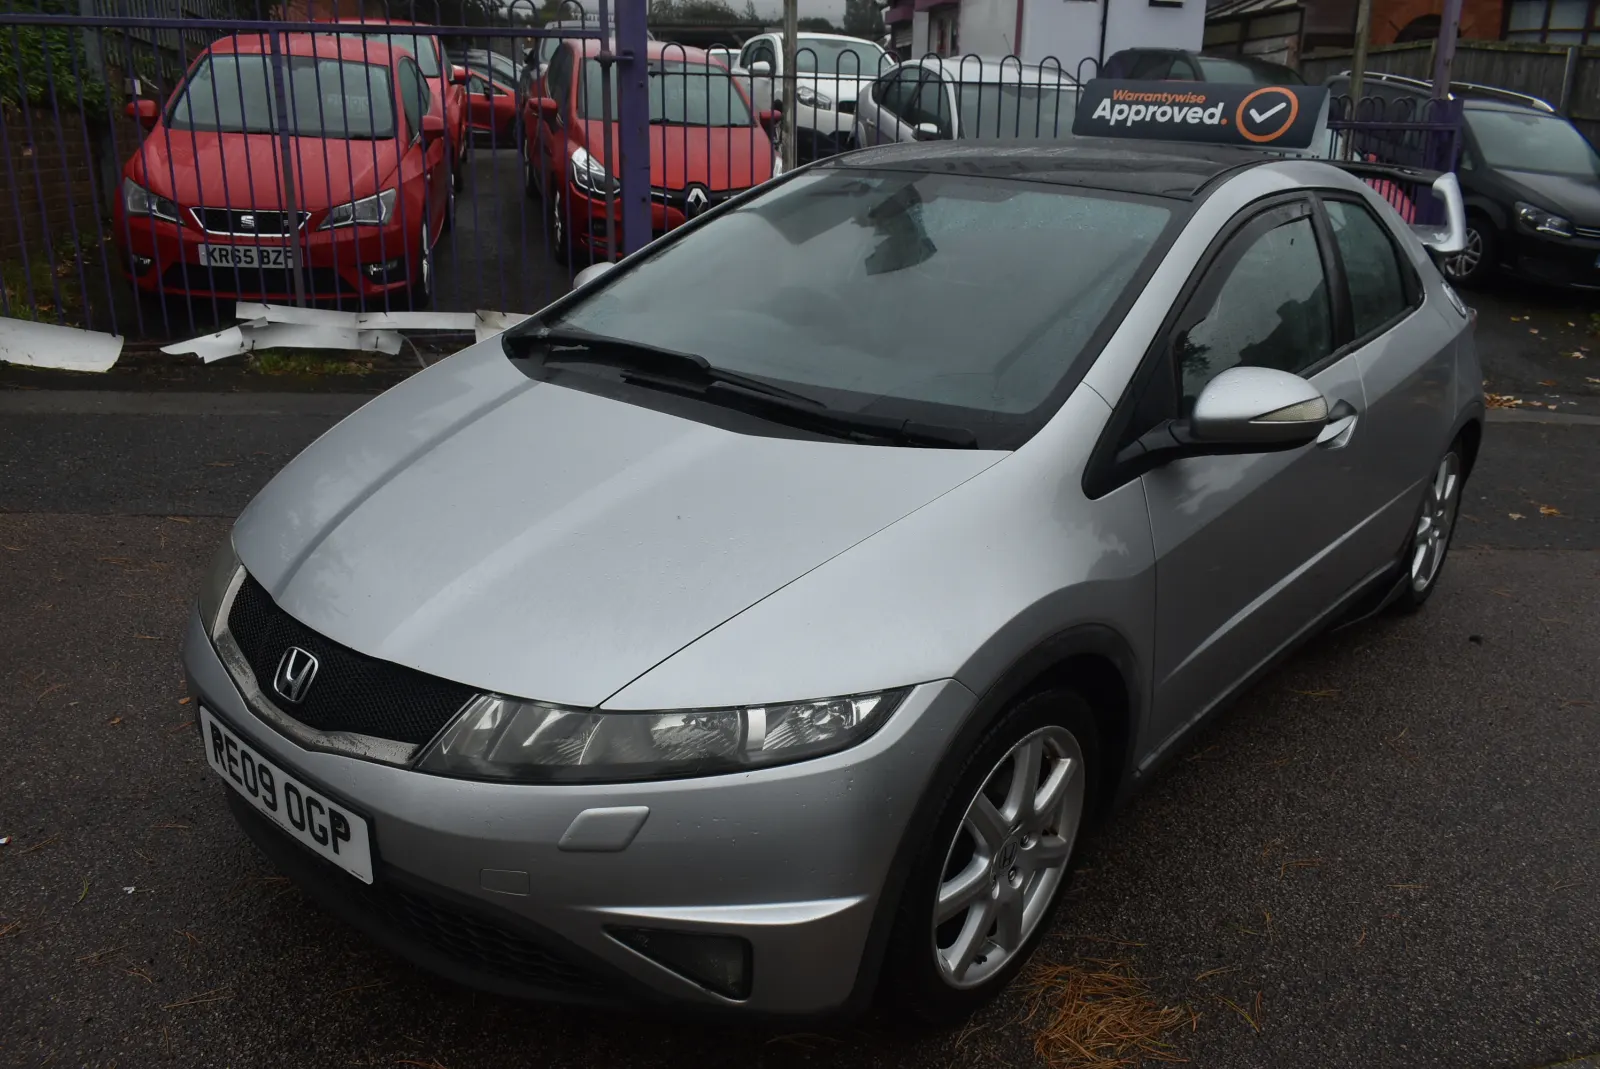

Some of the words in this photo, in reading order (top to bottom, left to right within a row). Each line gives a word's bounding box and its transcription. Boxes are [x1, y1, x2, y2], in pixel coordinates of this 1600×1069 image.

[1113, 89, 1206, 104] Warrantywise
[1092, 98, 1228, 126] Approved.
[207, 247, 254, 265] KR65
[209, 720, 278, 812] RE09
[284, 781, 351, 855] OGP
